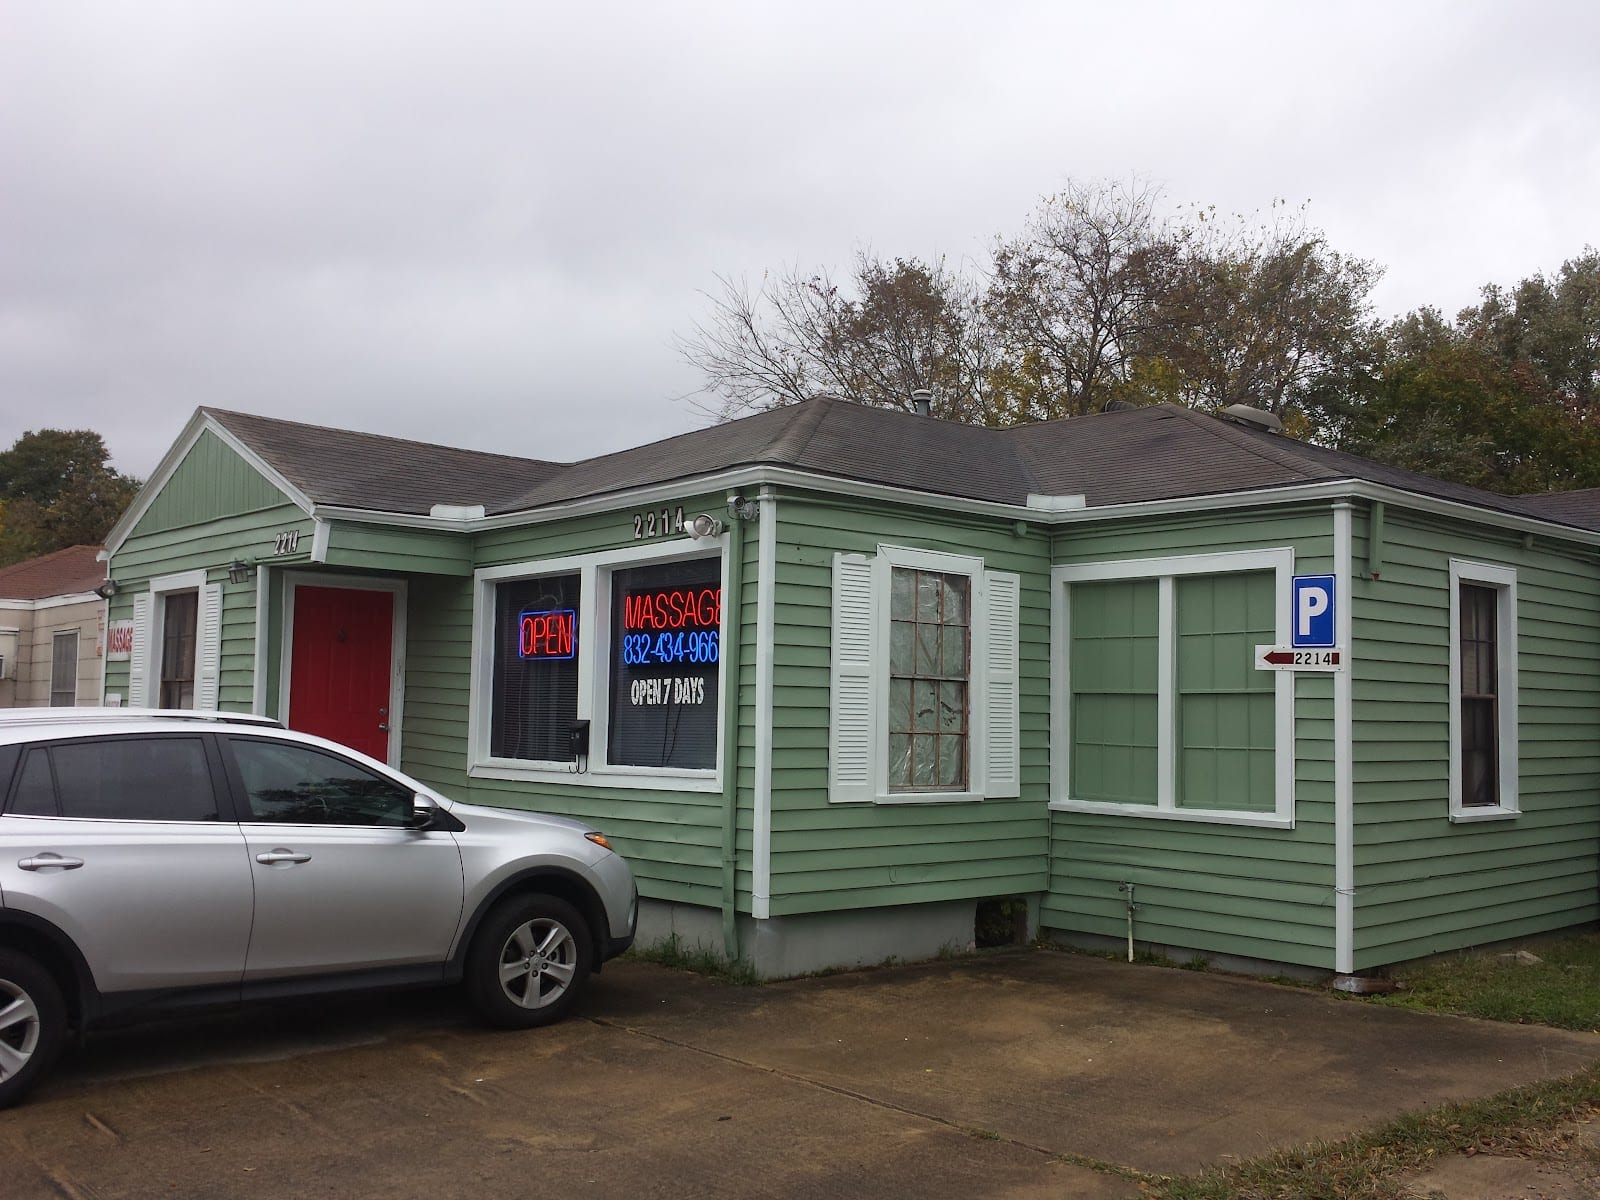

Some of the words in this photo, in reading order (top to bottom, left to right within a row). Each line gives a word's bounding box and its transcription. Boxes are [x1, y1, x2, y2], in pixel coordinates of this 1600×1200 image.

[634, 506, 684, 540] 2214
[274, 530, 299, 555] 2214
[1298, 587, 1329, 636] P
[521, 614, 573, 655] OPEN
[623, 631, 720, 664] 832-434-966
[1295, 652, 1331, 666] 2214
[630, 678, 662, 706] OPEN
[663, 678, 672, 705] 7
[674, 677, 705, 705] DAYS
